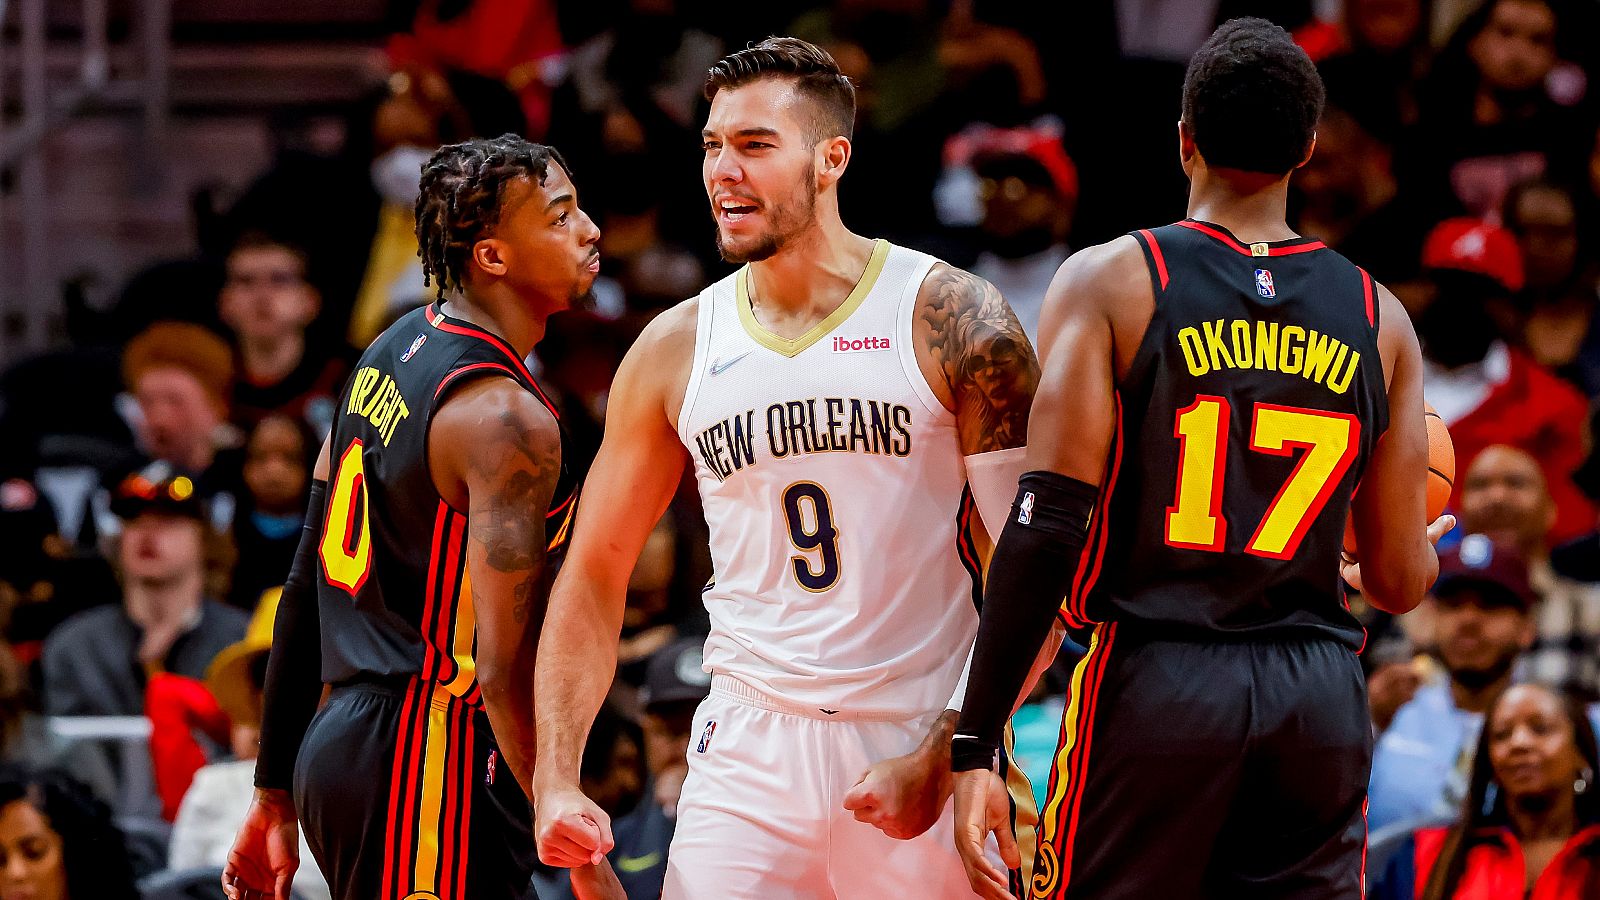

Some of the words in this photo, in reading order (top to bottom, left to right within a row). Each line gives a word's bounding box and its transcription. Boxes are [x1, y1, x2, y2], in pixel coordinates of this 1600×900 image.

[833, 336, 891, 352] ibotta
[1177, 318, 1361, 395] OKONGWU
[346, 366, 410, 448] WRIGHT
[695, 408, 757, 483] NEW
[766, 397, 913, 459] ORLEANS
[317, 436, 373, 597] 0
[1164, 393, 1362, 561] 17
[780, 479, 843, 594] 9
